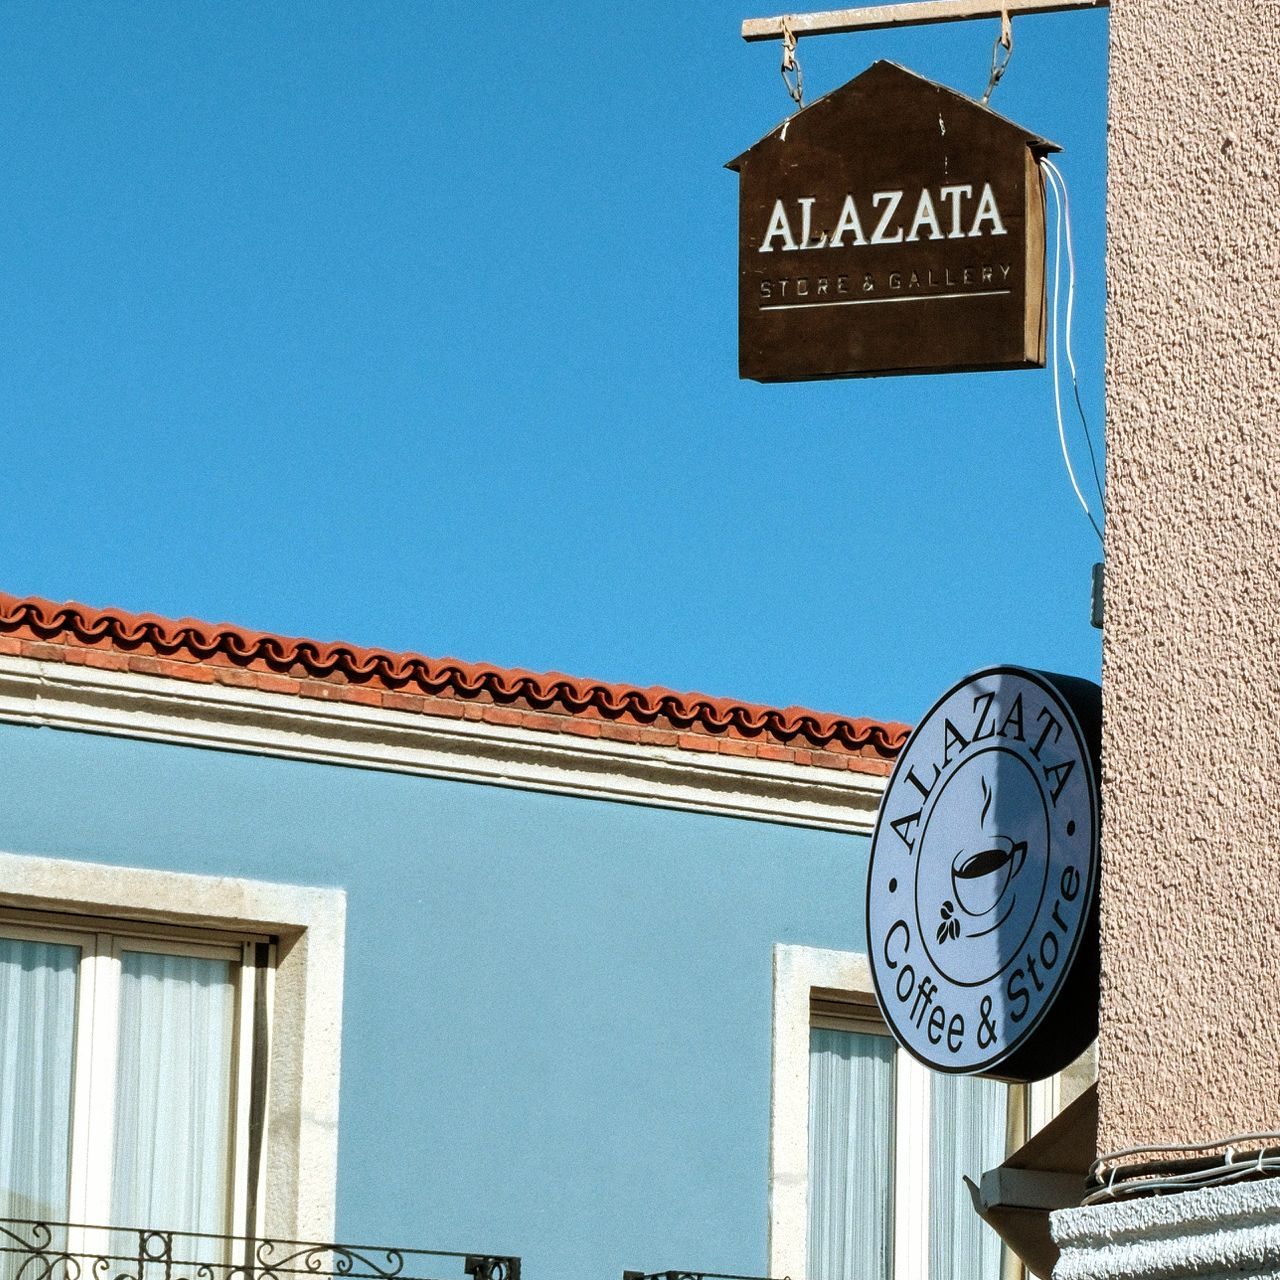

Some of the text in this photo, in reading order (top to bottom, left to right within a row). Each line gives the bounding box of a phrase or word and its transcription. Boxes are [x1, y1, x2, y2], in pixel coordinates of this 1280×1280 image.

[759, 182, 1008, 252] ALAZATA
[760, 265, 1011, 299] STORE & GALLERY
[889, 691, 1076, 854] ALAZATA
[884, 863, 1080, 1054] Coffee & Store
